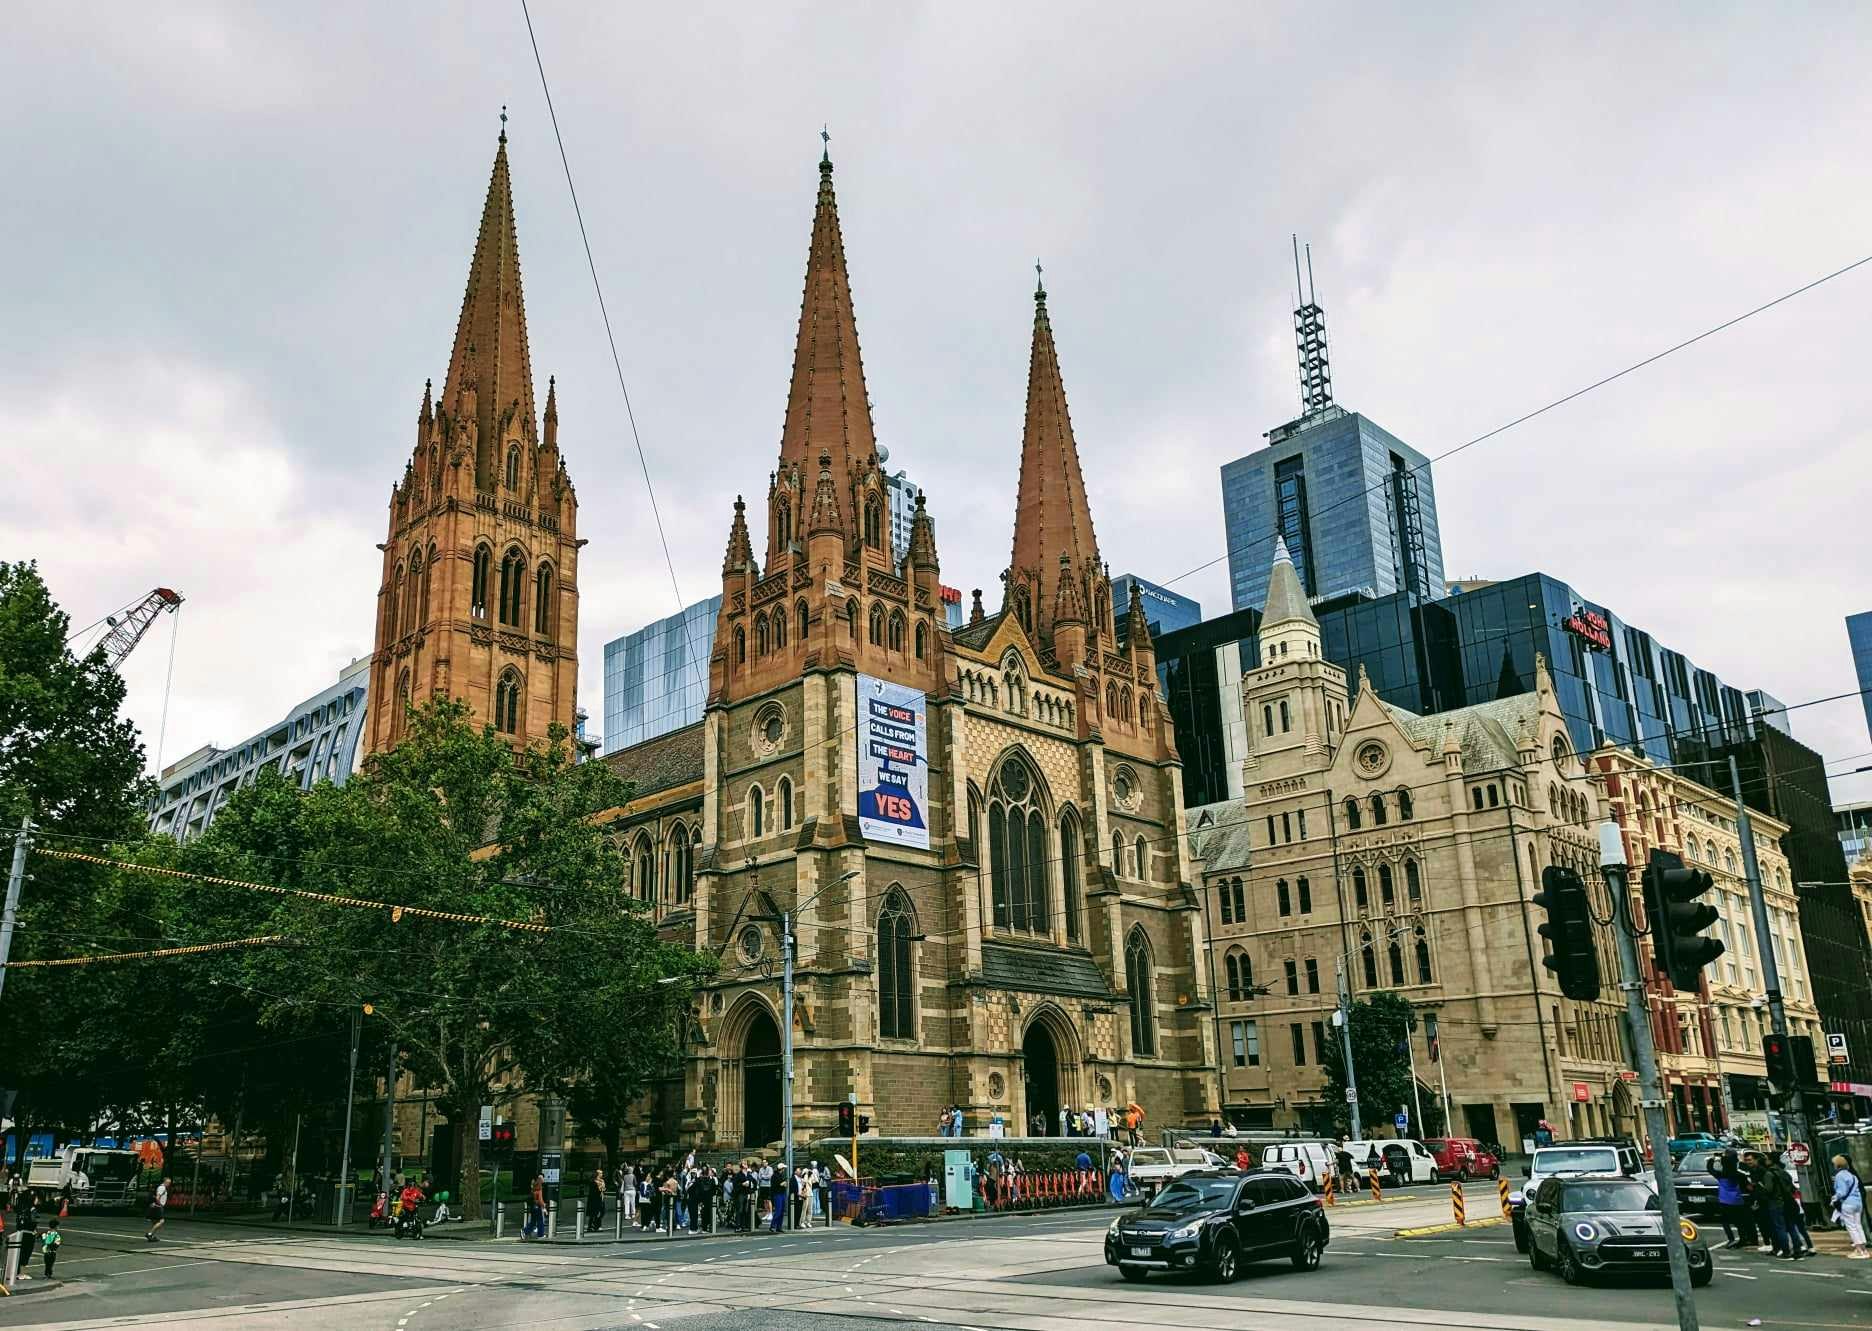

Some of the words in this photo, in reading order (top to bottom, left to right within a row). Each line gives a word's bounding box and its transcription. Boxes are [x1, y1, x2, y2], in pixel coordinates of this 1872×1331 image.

[1586, 611, 1609, 631] JOHN
[1569, 616, 1611, 648] HOLLAND
[873, 703, 888, 716] THE
[888, 708, 911, 722] VOICE
[870, 722, 894, 738] CALLS
[894, 730, 915, 743] FROM
[873, 743, 888, 757] THE
[888, 747, 914, 762] HEART
[879, 770, 892, 783] WE
[891, 772, 907, 786] SAY
[875, 792, 912, 821] YES
[1831, 1037, 1840, 1046] P
